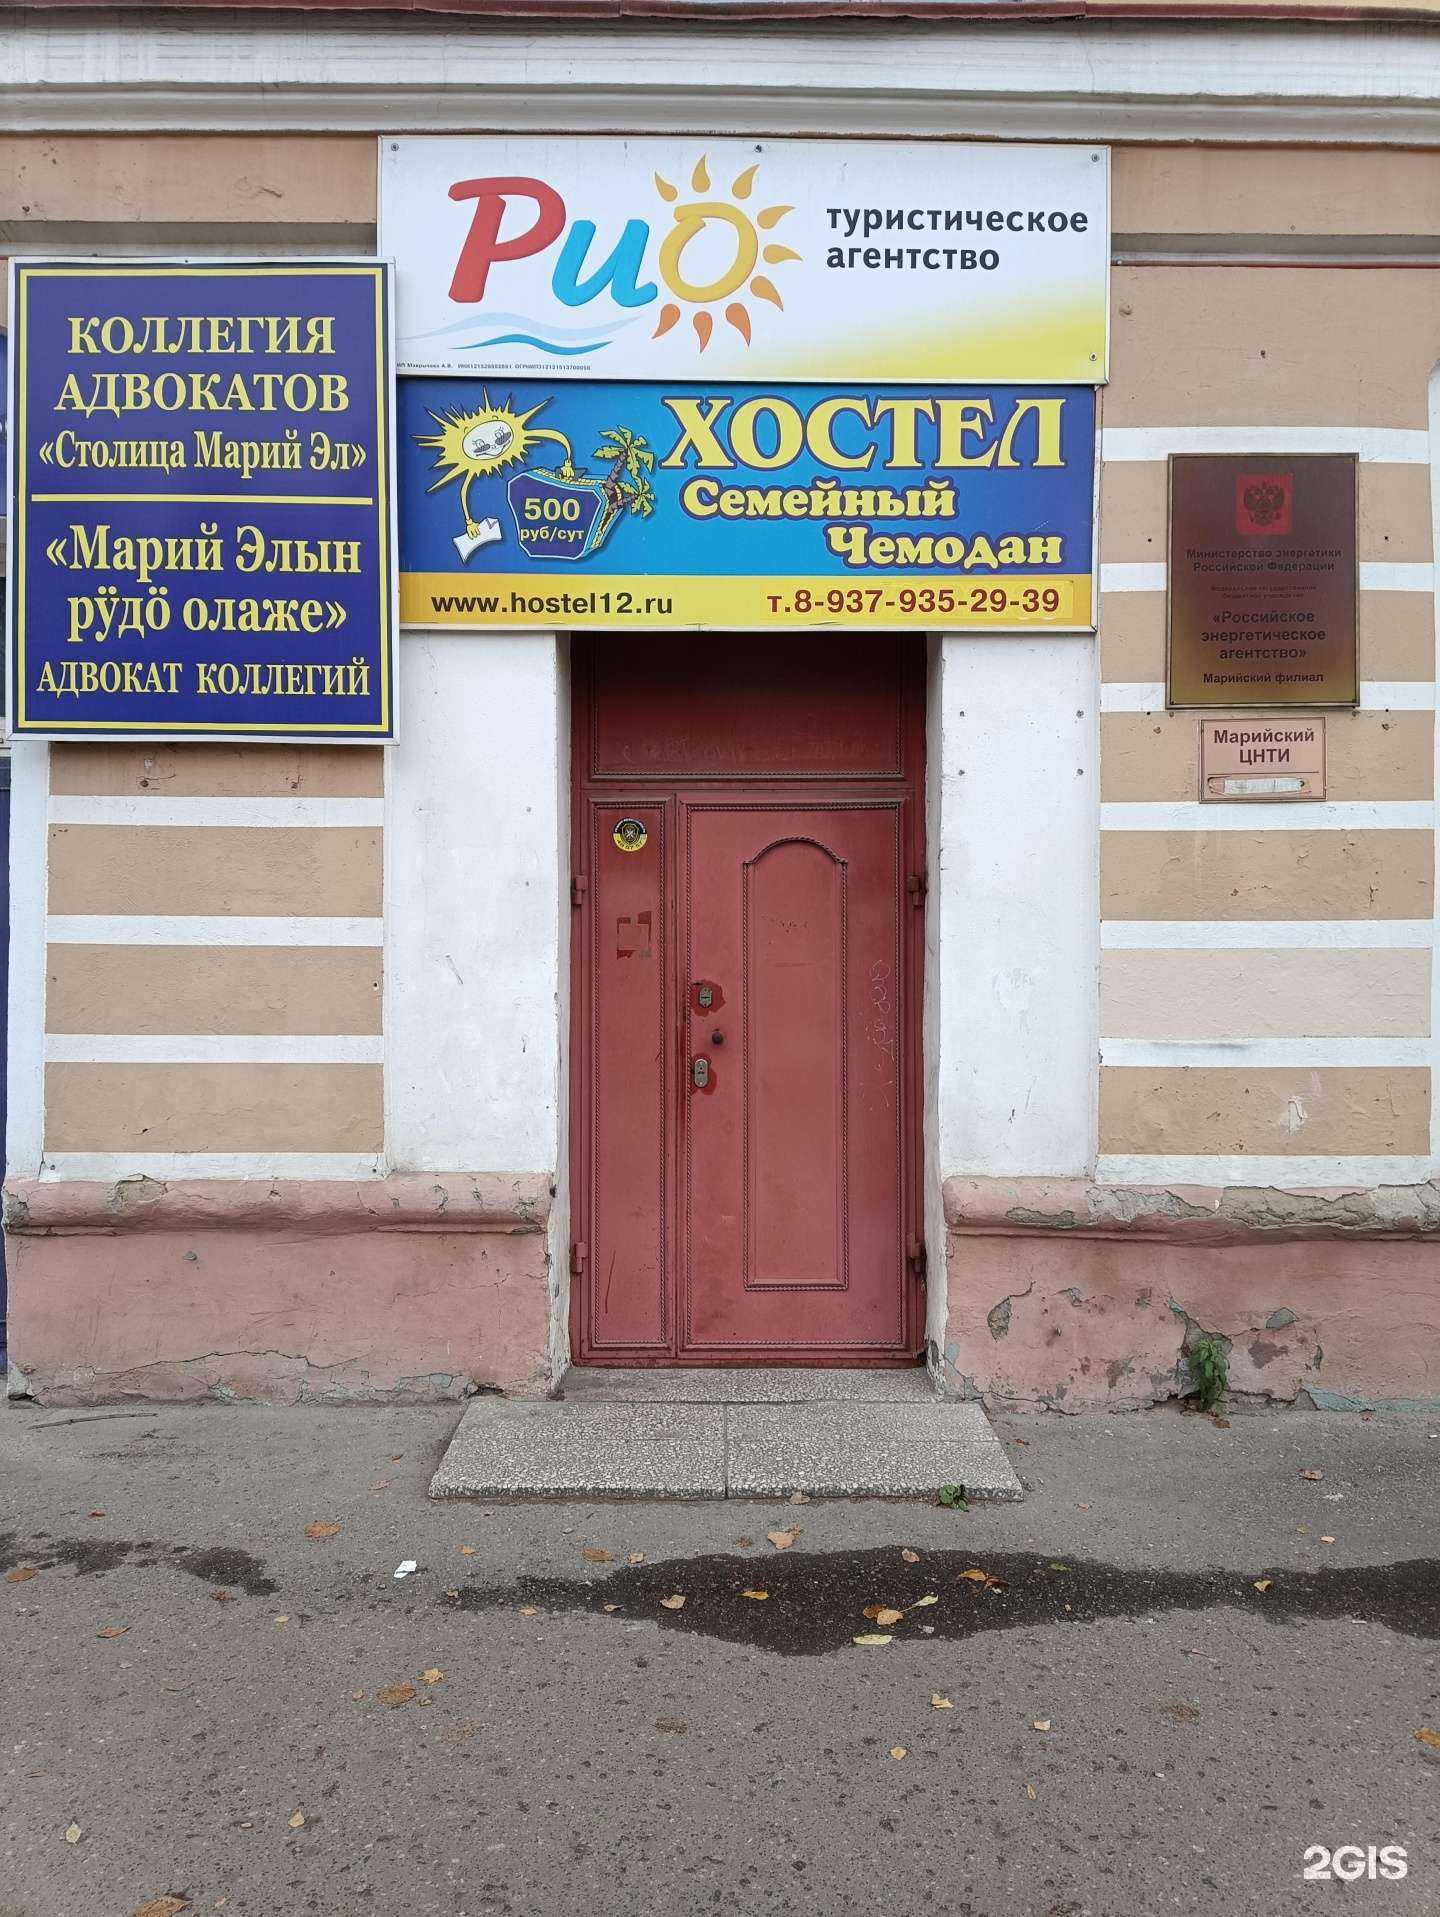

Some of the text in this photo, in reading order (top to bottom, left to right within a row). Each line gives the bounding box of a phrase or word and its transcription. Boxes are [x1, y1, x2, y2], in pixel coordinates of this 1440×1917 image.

[827, 205, 1088, 237] туристическое
[826, 245, 1000, 271] агентство
[66, 315, 336, 355] КОЛЛЕГИЯ
[53, 372, 351, 419] АДВОКАТОВ
[661, 397, 1067, 468] ХОСТЕЛ
[38, 429, 368, 479] «Столица Марий Эл»
[524, 498, 580, 520] 500
[683, 478, 956, 518] Семейный
[520, 526, 584, 542] руб/сут
[46, 522, 362, 583] «Марий Элын
[827, 526, 1063, 569] Чемодан
[1186, 548, 1342, 559] Министерство энергетики
[1193, 560, 1335, 573] Российской Федерации
[431, 592, 672, 614] www.hostel12.ru
[767, 588, 1060, 613] т.8-937-935-29-39
[182, 595, 348, 633] олаже»
[1213, 610, 1316, 625] «Российское
[1200, 629, 1327, 645] энергетическое
[1219, 647, 1307, 660] агентство»
[36, 656, 370, 698] АДВОКАТ КОЛЛЕГИЙ
[1203, 672, 1324, 686] Марийский филиал
[1214, 728, 1314, 746] Марийский
[1239, 748, 1290, 765] ЦНТИ
